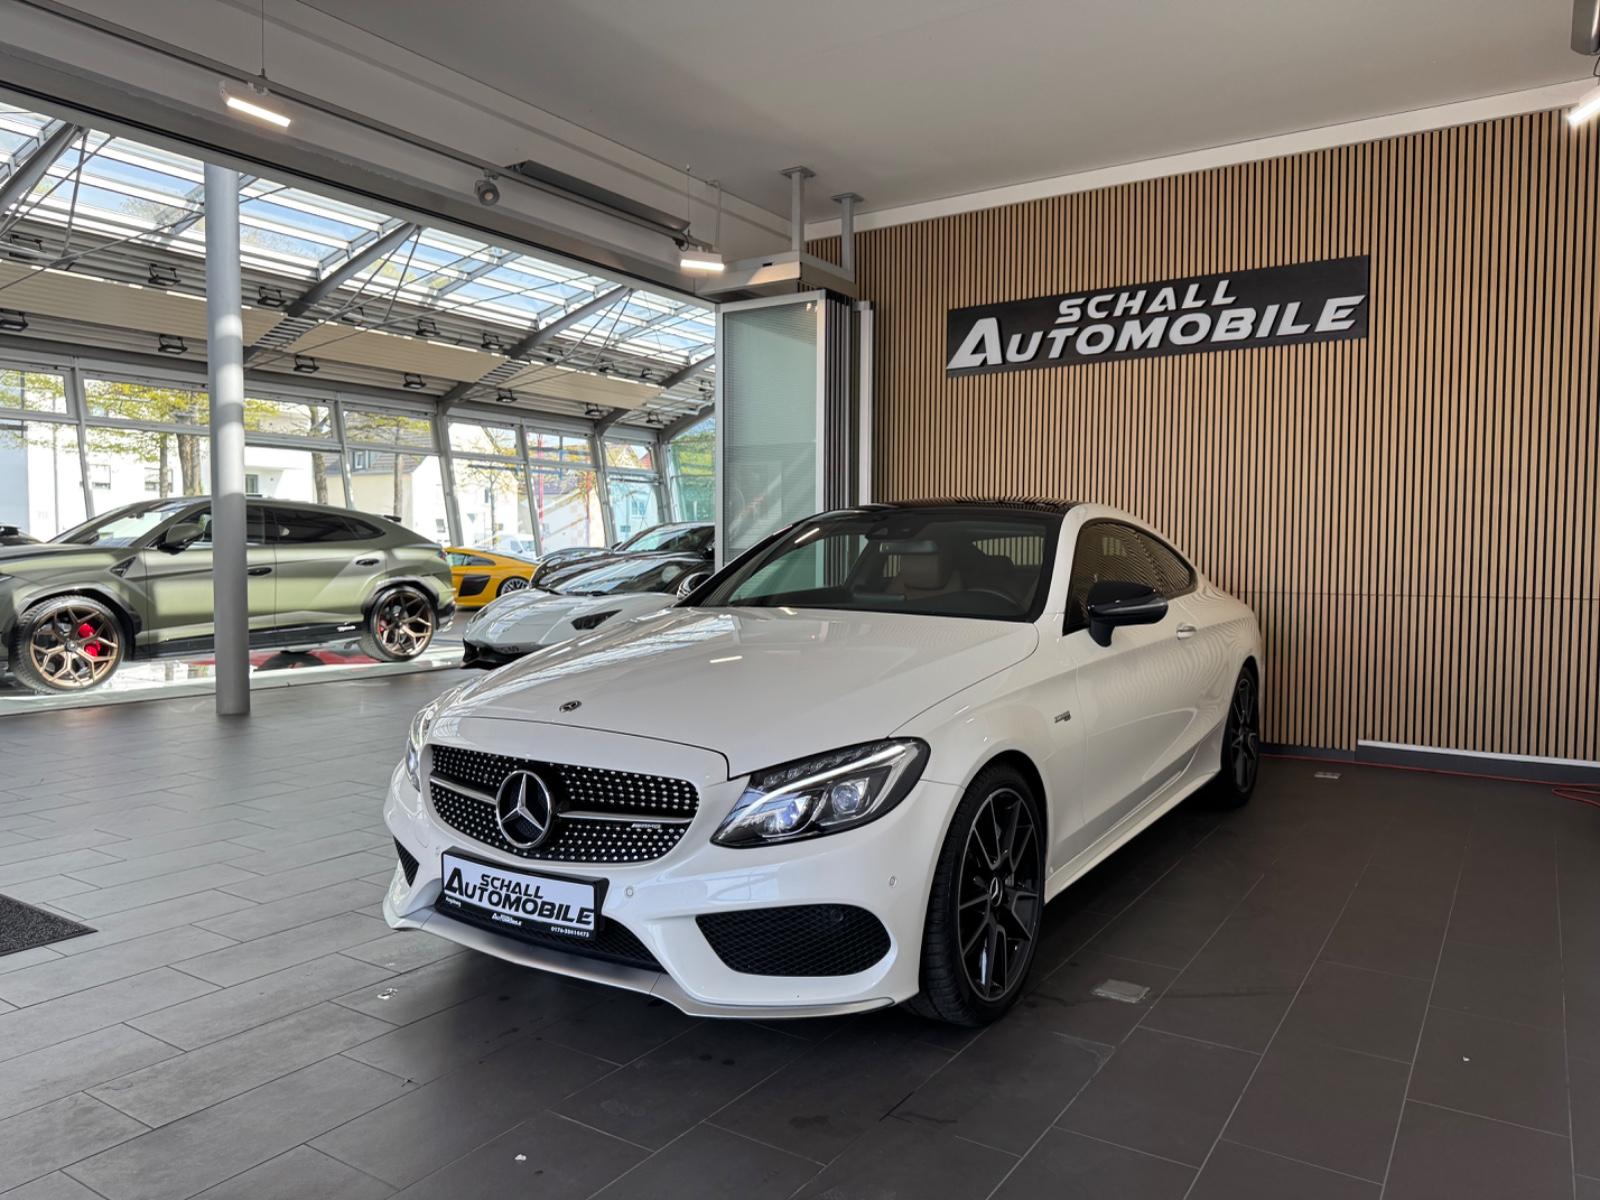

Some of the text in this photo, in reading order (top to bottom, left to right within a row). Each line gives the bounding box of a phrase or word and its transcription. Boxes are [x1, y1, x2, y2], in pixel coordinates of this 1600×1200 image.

[1055, 279, 1238, 324] SCHALL
[946, 294, 1367, 370] AUTOMOBILE
[444, 867, 595, 926] AUTOMOBILE
[480, 873, 544, 900] SCHALL
